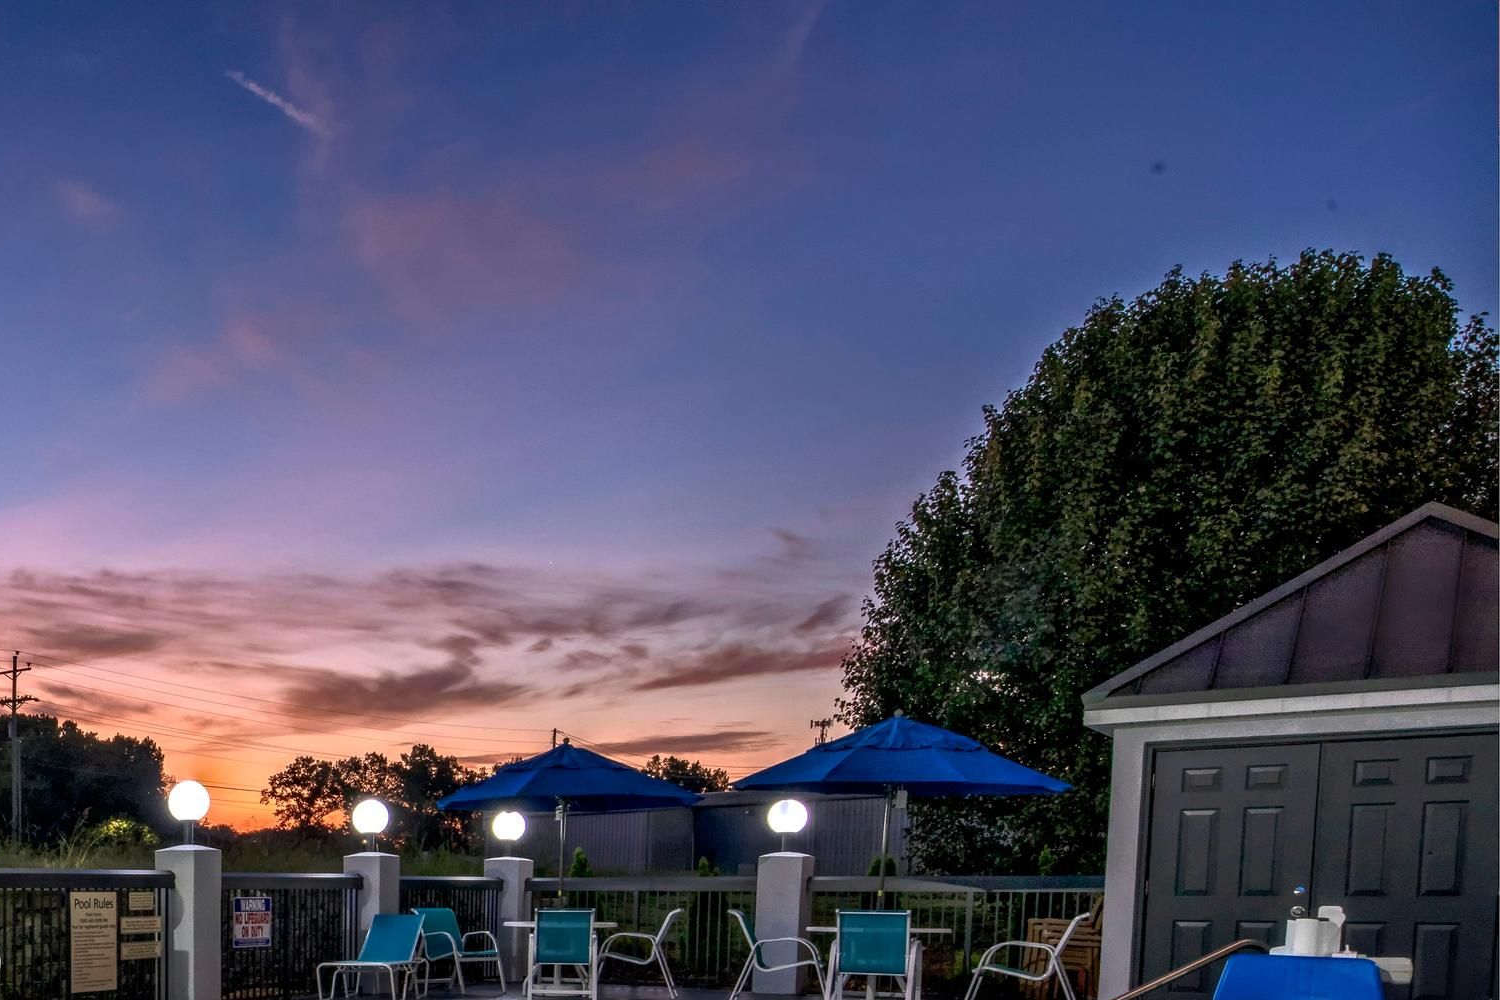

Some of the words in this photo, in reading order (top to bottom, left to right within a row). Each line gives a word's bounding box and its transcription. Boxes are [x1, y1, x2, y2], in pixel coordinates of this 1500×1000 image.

[74, 897, 91, 909] Pool
[93, 897, 114, 909] Rules
[240, 899, 266, 911] WARNING
[235, 912, 243, 925] NO
[244, 912, 269, 925] LIFEGUARD
[241, 926, 249, 938] ON
[251, 926, 264, 938] DUTY
